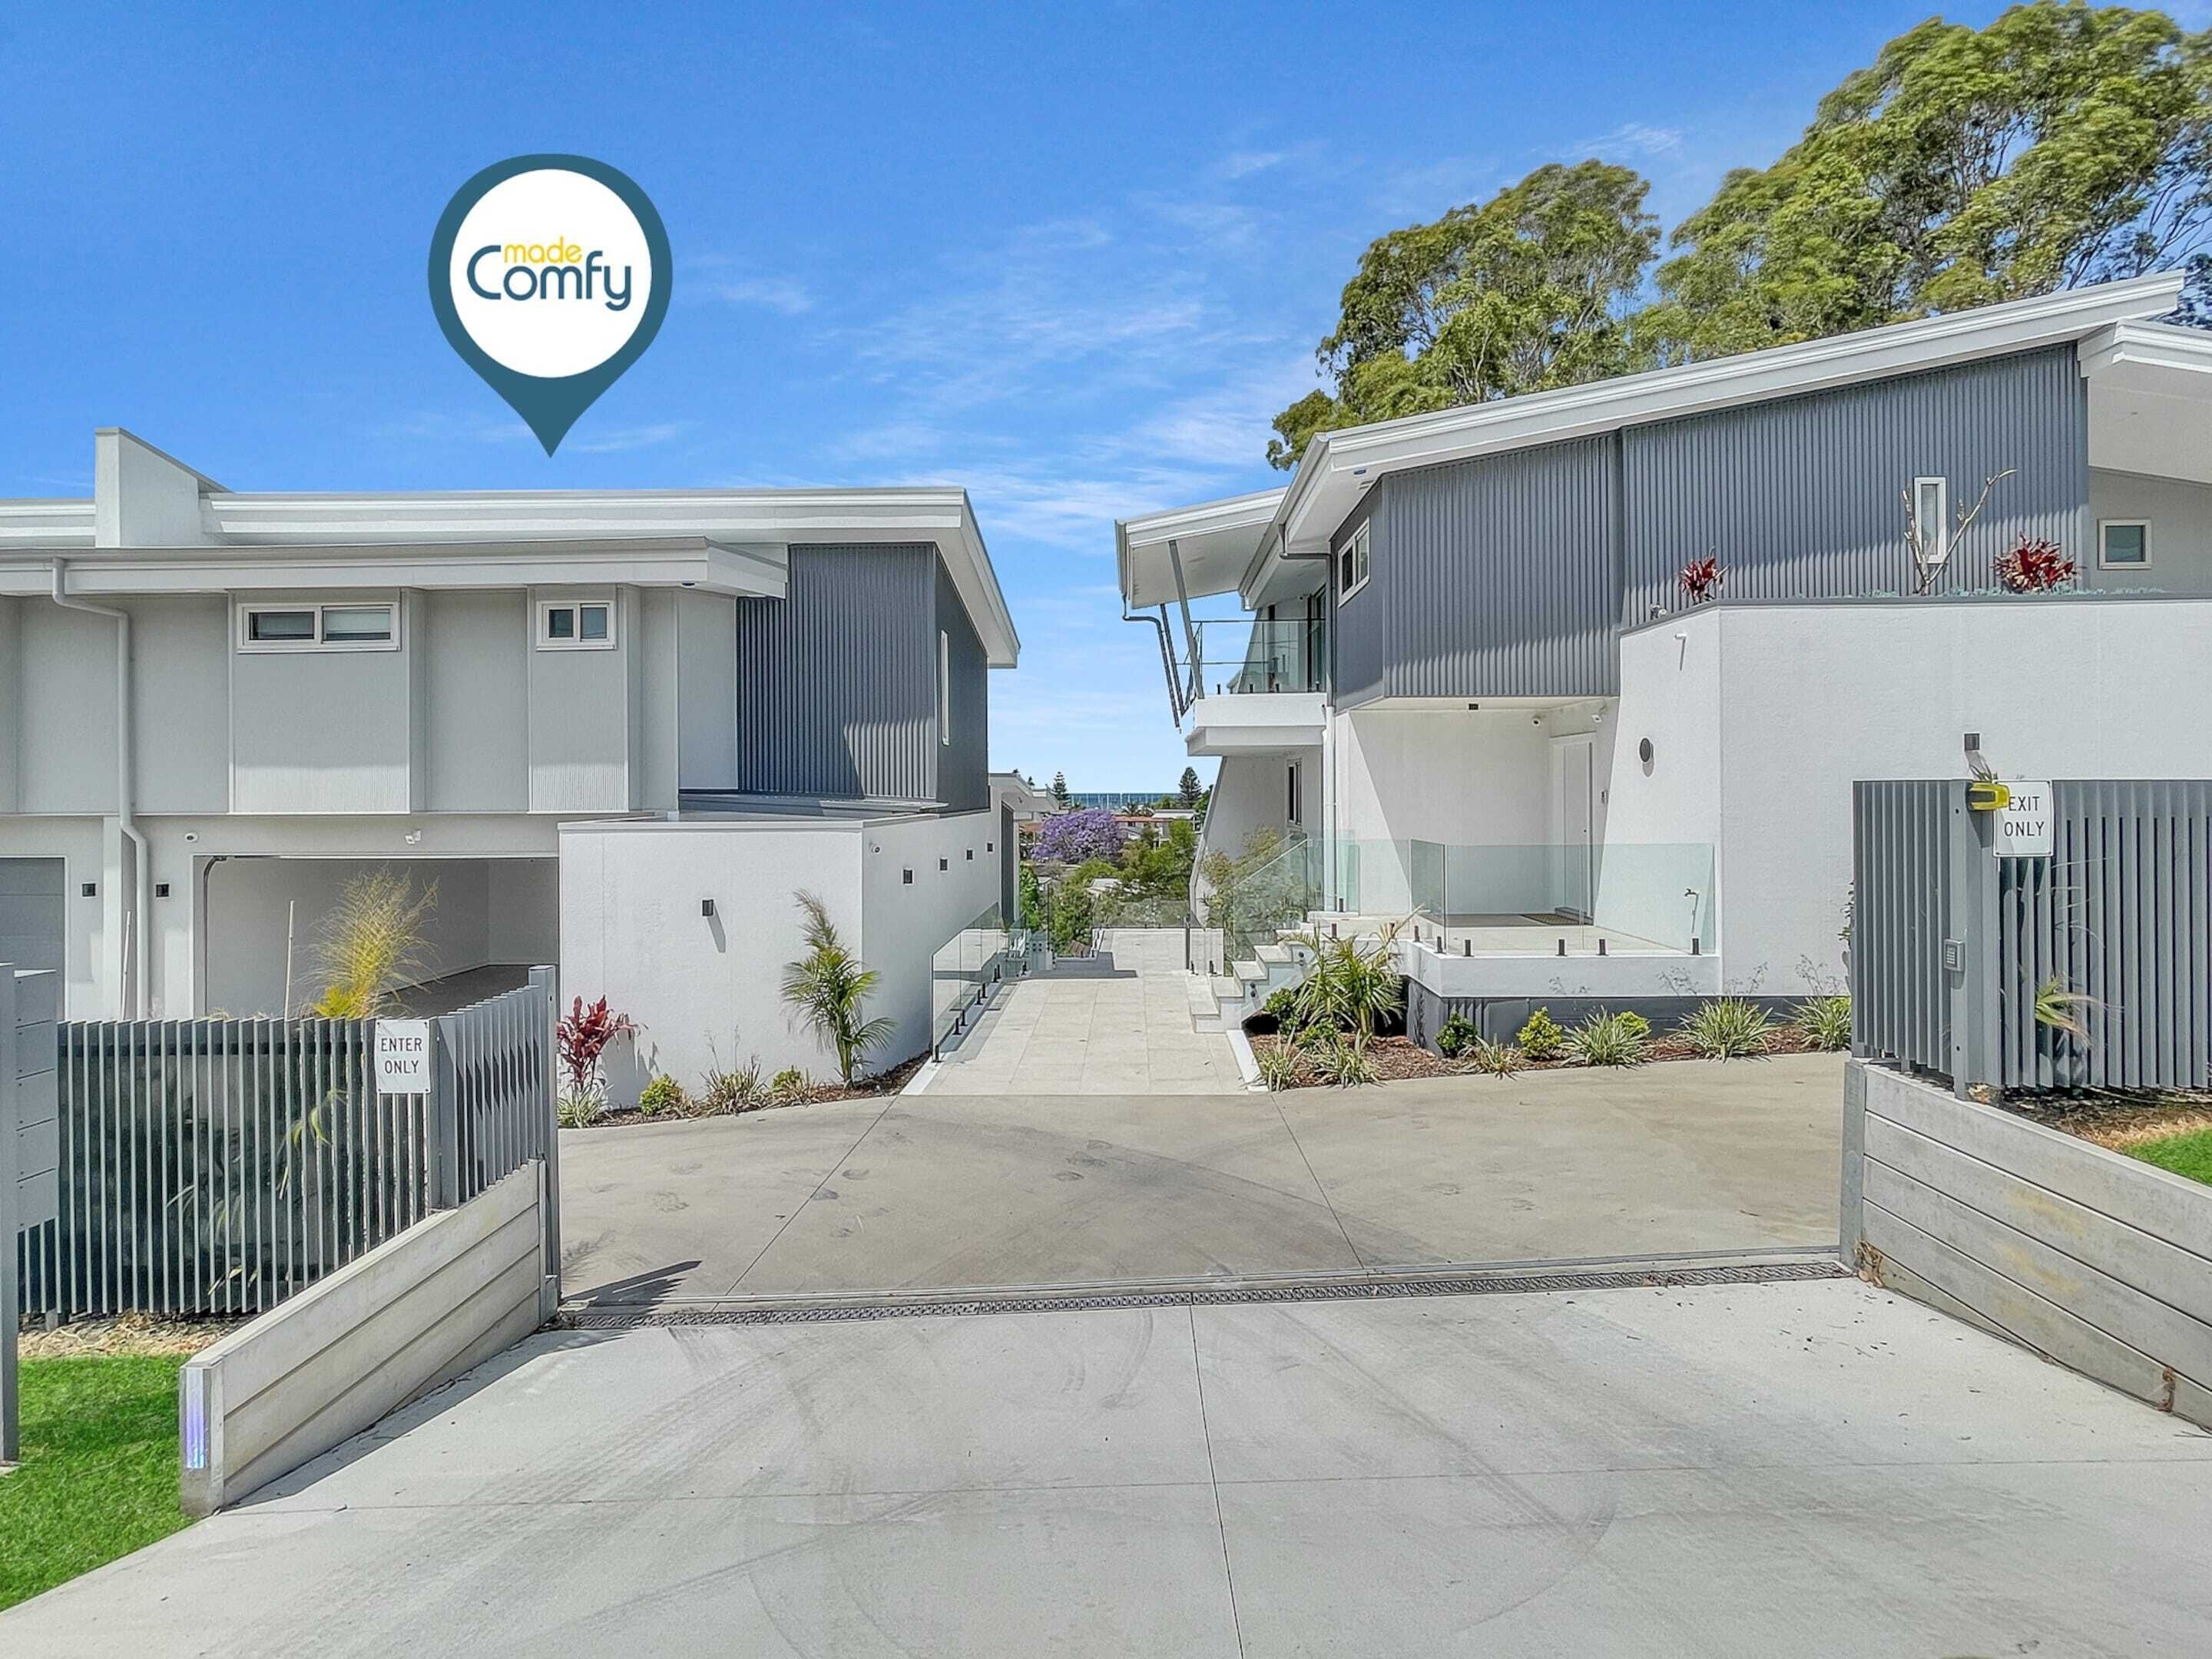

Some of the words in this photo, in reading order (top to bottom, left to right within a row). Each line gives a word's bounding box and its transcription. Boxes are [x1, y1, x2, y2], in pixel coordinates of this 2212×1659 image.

[2008, 796, 2040, 811] EXIT
[2004, 821, 2045, 836] ONLY
[381, 1038, 422, 1051] ENTER
[384, 1060, 419, 1074] ONLY
